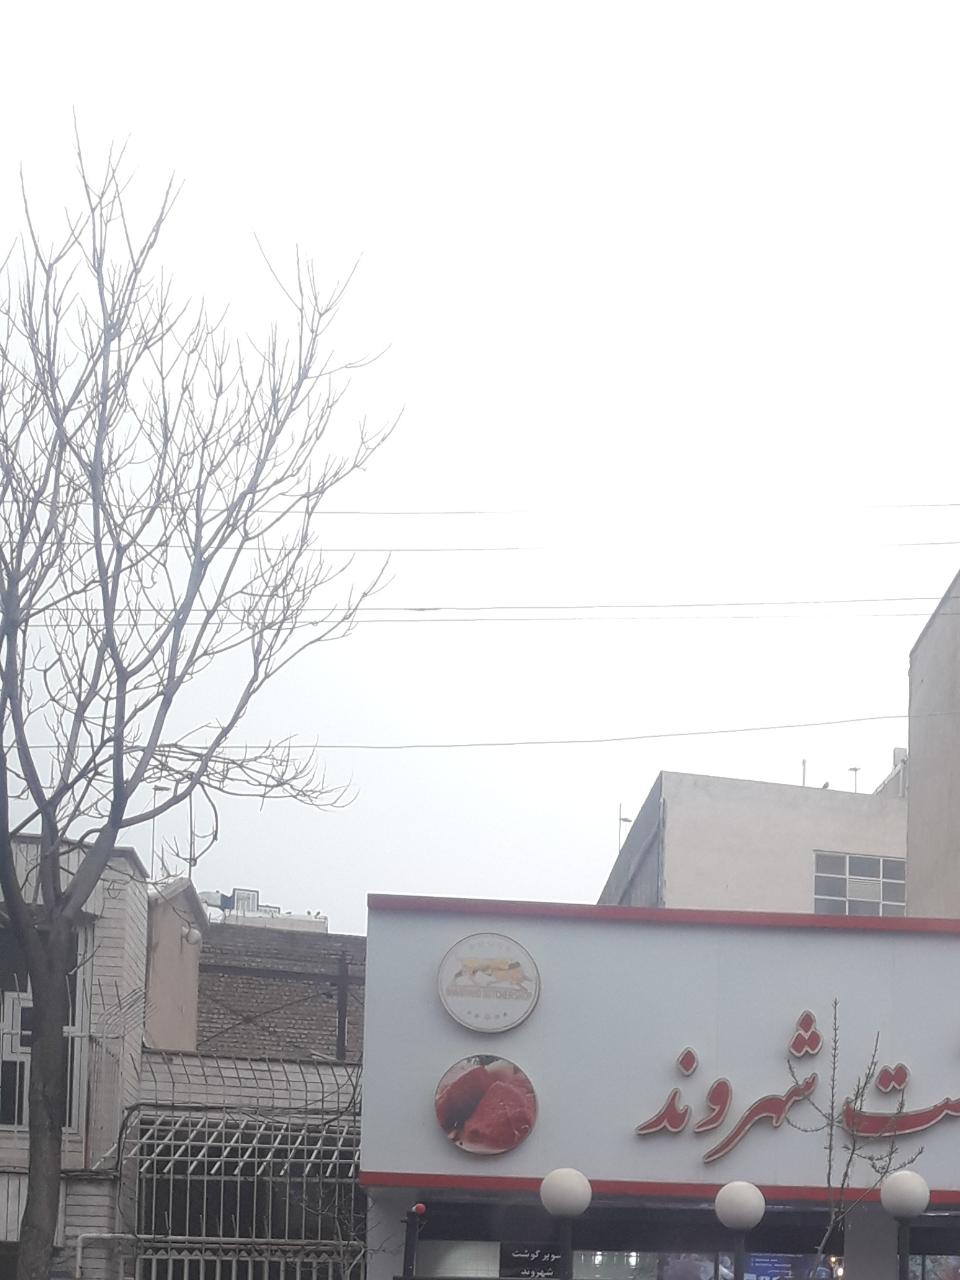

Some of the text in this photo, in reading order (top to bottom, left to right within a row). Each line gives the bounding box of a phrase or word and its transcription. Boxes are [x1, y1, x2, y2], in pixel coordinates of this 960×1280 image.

[635, 1009, 825, 1164] شهروند
[512, 1250, 561, 1263] سوپر گوشت
[521, 1267, 553, 1278] شهروند
